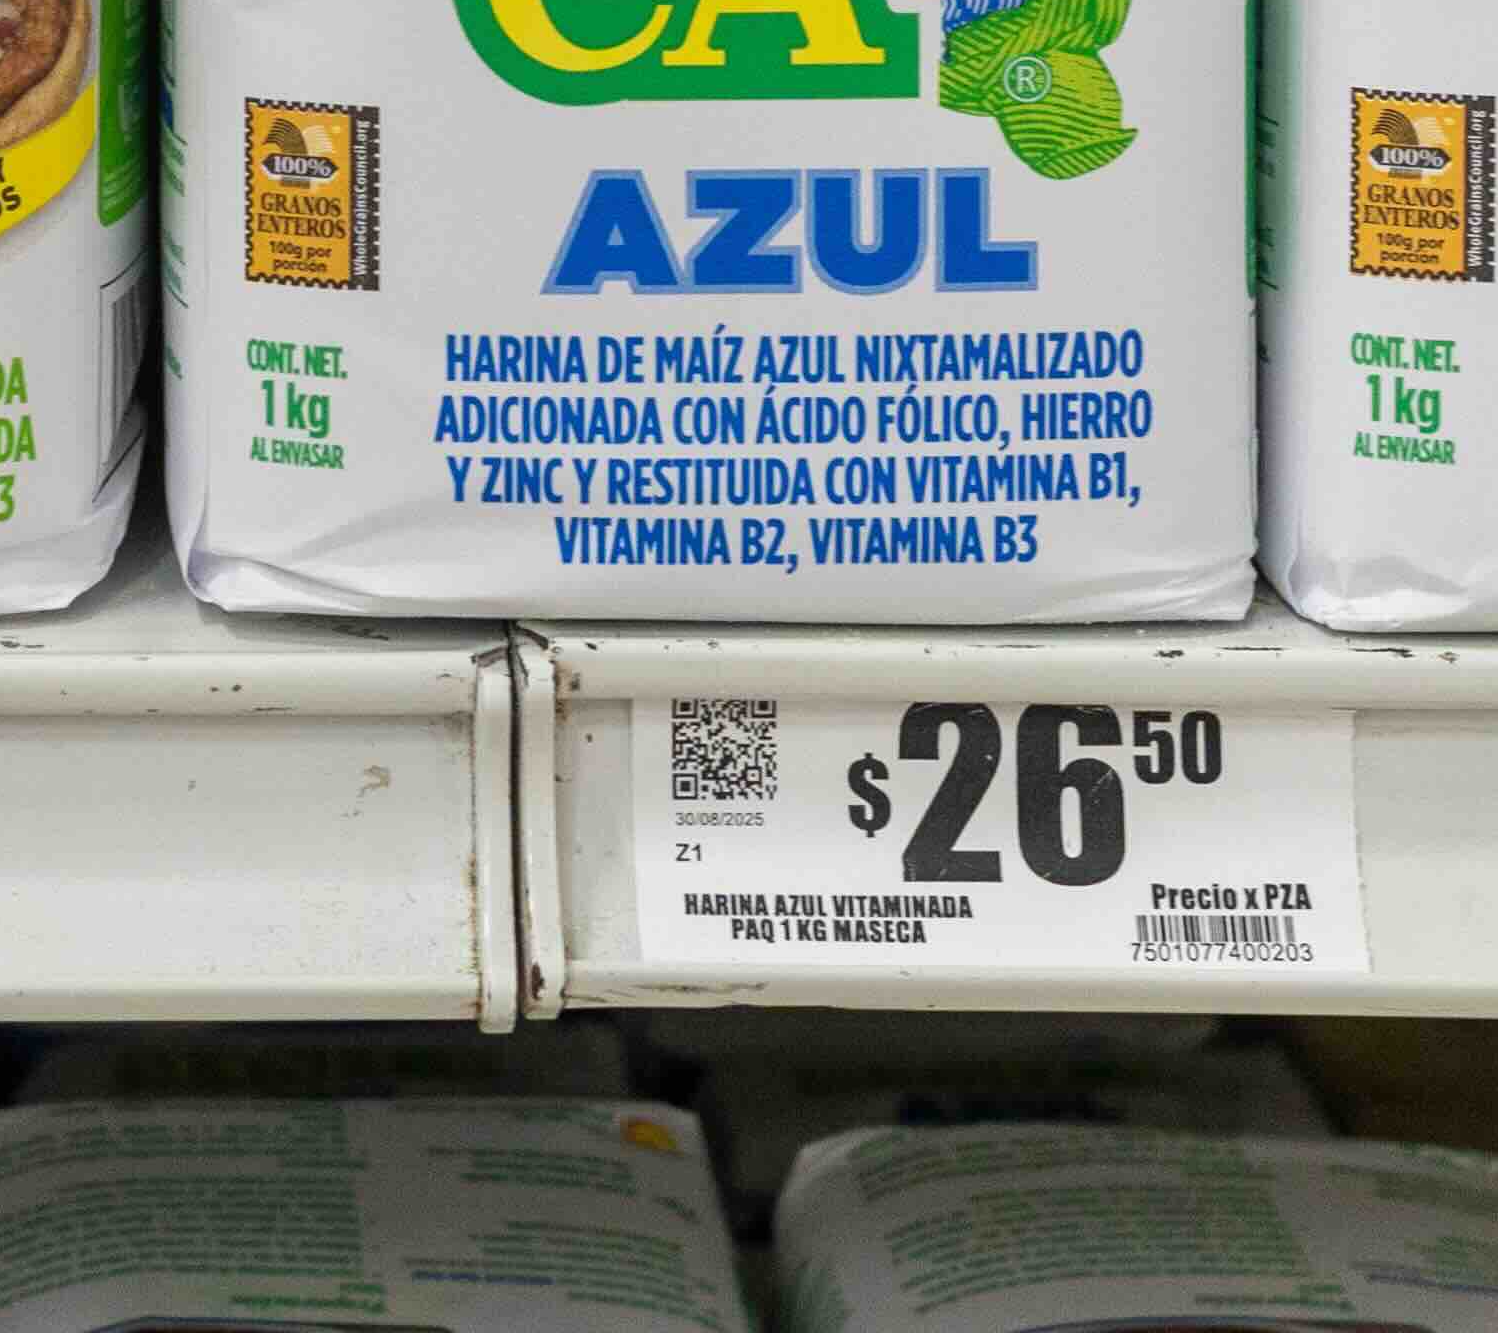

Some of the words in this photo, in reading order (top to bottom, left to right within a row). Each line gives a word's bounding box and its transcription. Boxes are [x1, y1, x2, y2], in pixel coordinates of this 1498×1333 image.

[540, 168, 1039, 295] AZUL
[446, 333, 587, 383] HARINA
[598, 333, 645, 383] DE
[655, 325, 744, 383] MAÍZ
[753, 334, 841, 383] AZUL
[856, 329, 1143, 383] NIXTAMALIZADO
[675, 812, 764, 826] 30/08/2025
[675, 843, 702, 862] Z1
[684, 893, 768, 916] HARINA
[774, 894, 827, 917] AZUL
[832, 895, 972, 918] VITAMINADA
[1151, 884, 1238, 912] Precio
[1243, 890, 1258, 909] x
[1265, 884, 1312, 911] PZA
[732, 918, 776, 943] PAQ
[782, 920, 791, 941] 1
[797, 919, 827, 941] KG
[833, 920, 926, 943] MASECA
[1131, 941, 1314, 963] 7501077400203
